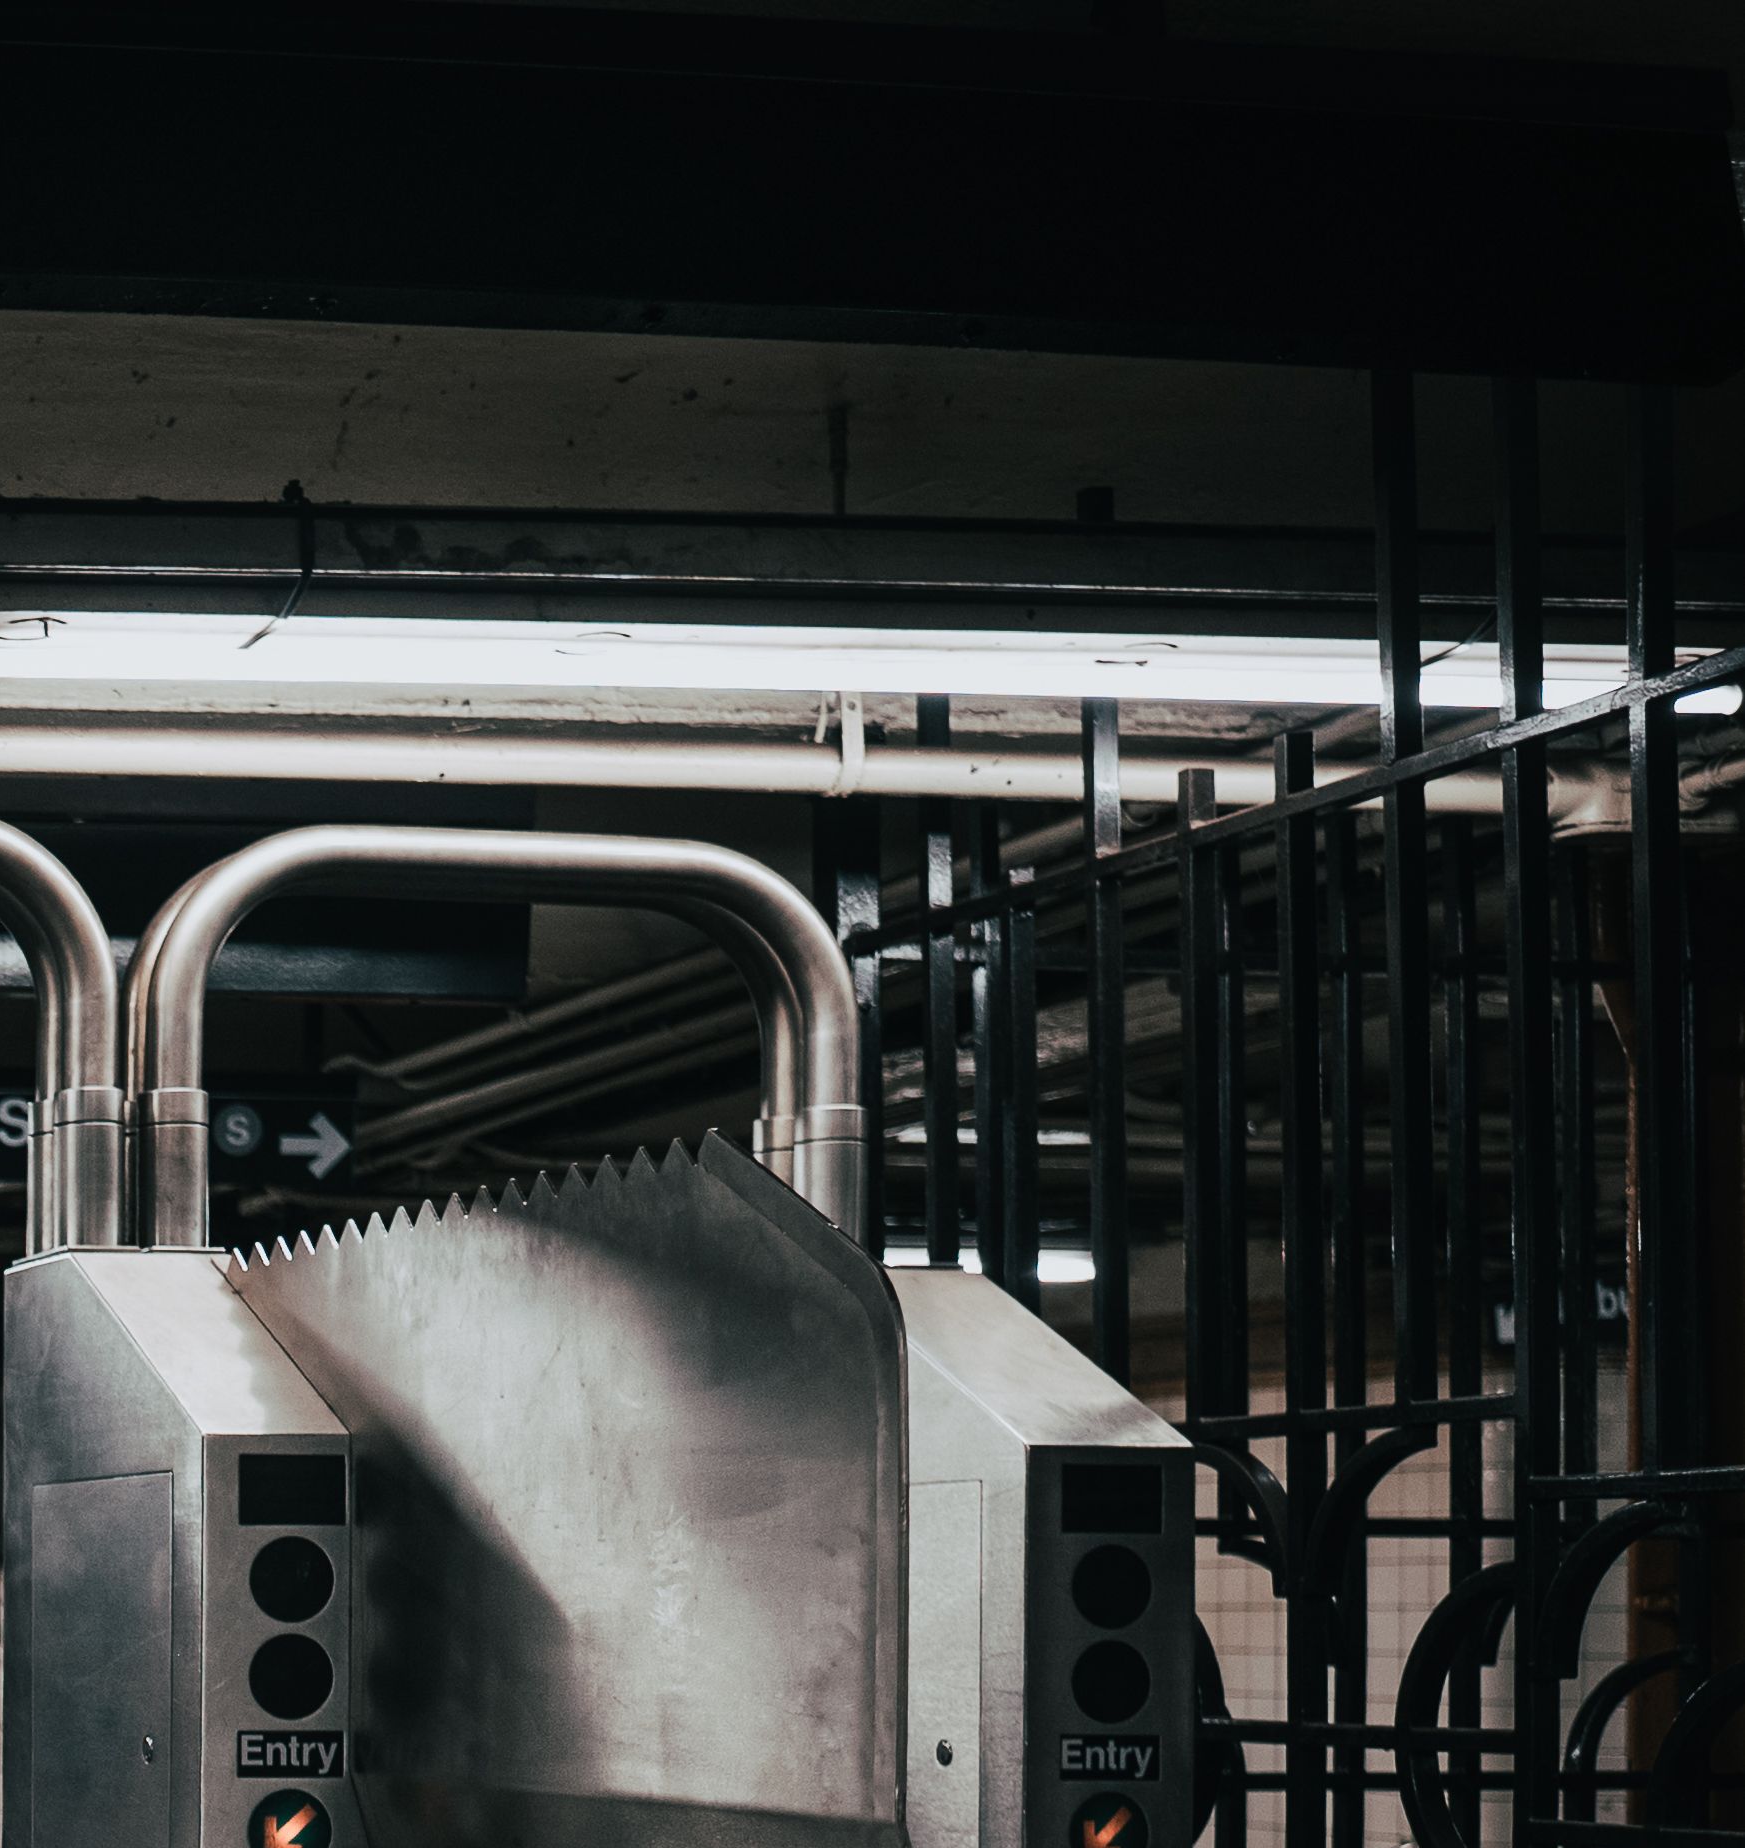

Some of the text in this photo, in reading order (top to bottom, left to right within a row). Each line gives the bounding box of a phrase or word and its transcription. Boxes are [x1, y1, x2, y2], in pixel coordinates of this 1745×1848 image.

[225, 1112, 251, 1147] S
[240, 1733, 339, 1775] Entry
[1061, 1738, 1154, 1779] Entry
